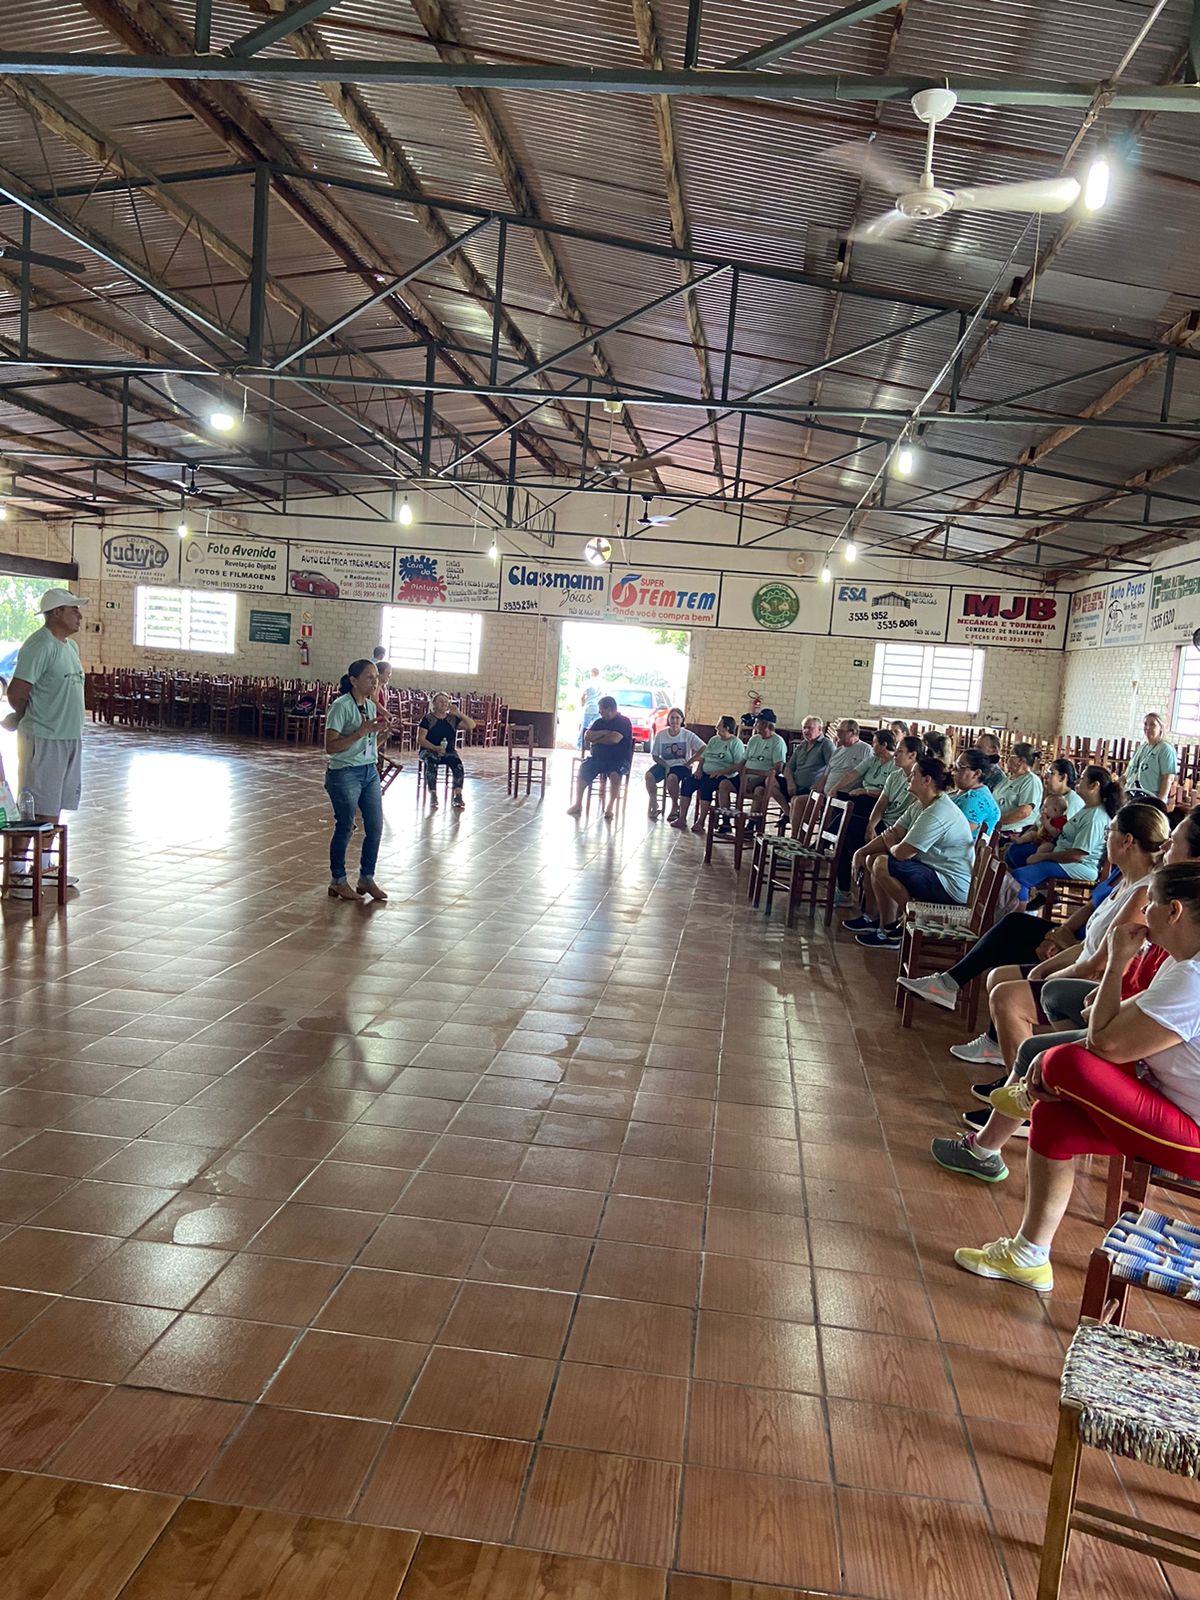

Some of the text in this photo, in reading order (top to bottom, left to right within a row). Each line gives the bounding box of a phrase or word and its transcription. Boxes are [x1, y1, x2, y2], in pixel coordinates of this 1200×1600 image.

[207, 543, 277, 559] Foto Avenida
[224, 560, 277, 571] Revelação Digital
[301, 555, 318, 564] AUTO
[194, 568, 220, 576] FOTOS
[229, 571, 276, 581] FILMAGENS
[508, 565, 604, 591] Classmann
[410, 583, 440, 592] Pintura
[640, 578, 665, 587] SUPER
[838, 586, 867, 602] ESA
[1109, 585, 1125, 601] Auto
[1126, 581, 1146, 600] Peças
[639, 588, 717, 610] TEMTEM
[962, 593, 1057, 622] MJB
[613, 607, 714, 622] Onde você compra bem!
[848, 612, 869, 622] 3535
[877, 620, 898, 630] 3535
[1009, 622, 1056, 630] TORNEARIA
[1008, 629, 1045, 637] ROLAMENTO
